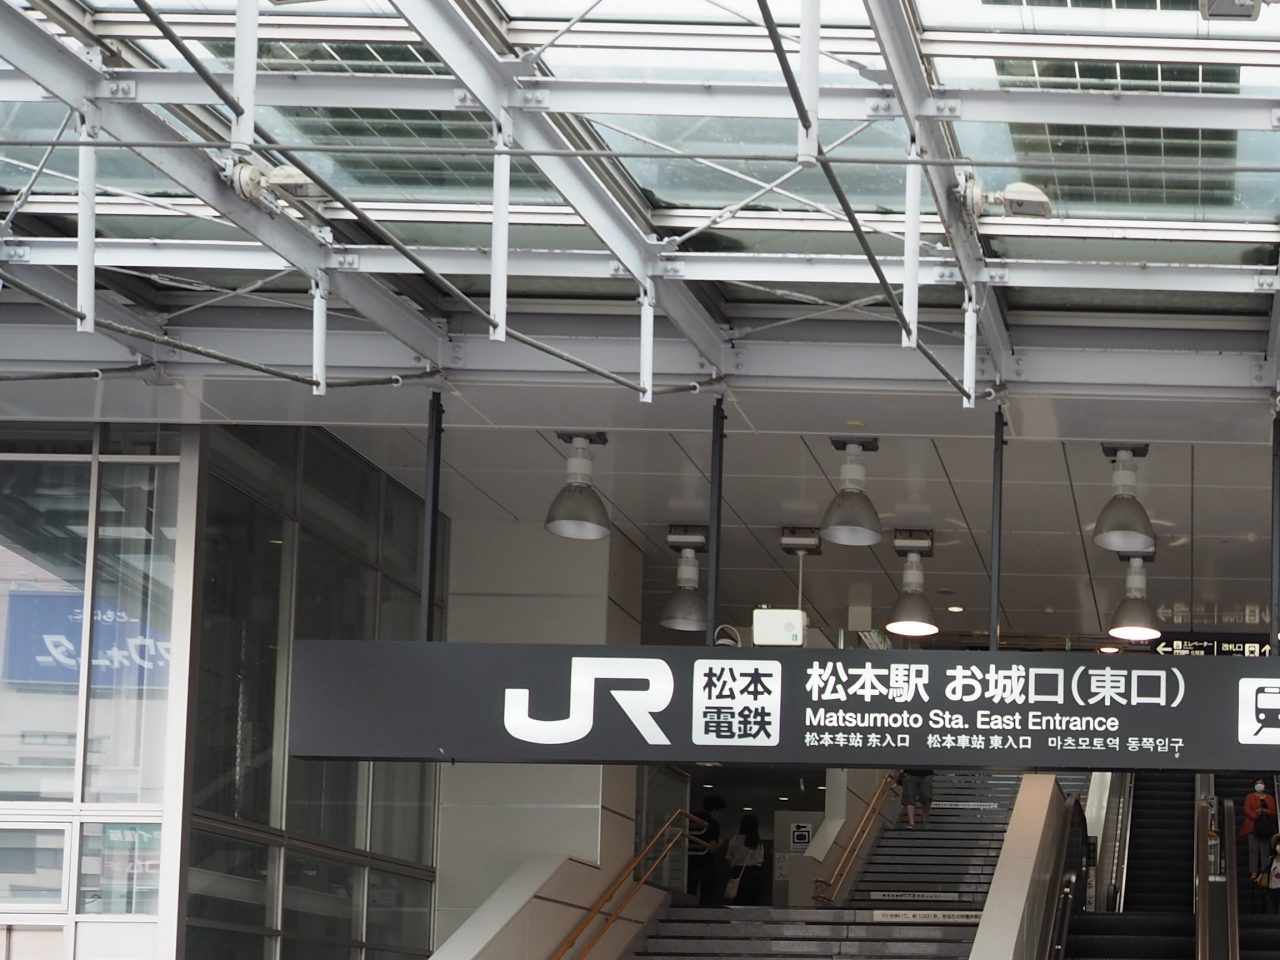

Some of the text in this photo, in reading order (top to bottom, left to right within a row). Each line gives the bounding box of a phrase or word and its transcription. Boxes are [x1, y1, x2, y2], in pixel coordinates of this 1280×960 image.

[703, 666, 774, 700] 松本
[806, 661, 930, 703] 松本駅
[504, 657, 674, 746] JR
[703, 706, 772, 739] 電鉄
[805, 708, 1119, 731] Matsumoto Sta. East Entrance
[805, 732, 910, 747] 松本车站 东入口
[927, 733, 1032, 749] 松本車站 東入口
[1048, 736, 1184, 752] 마츠모토역 동쪽입구
